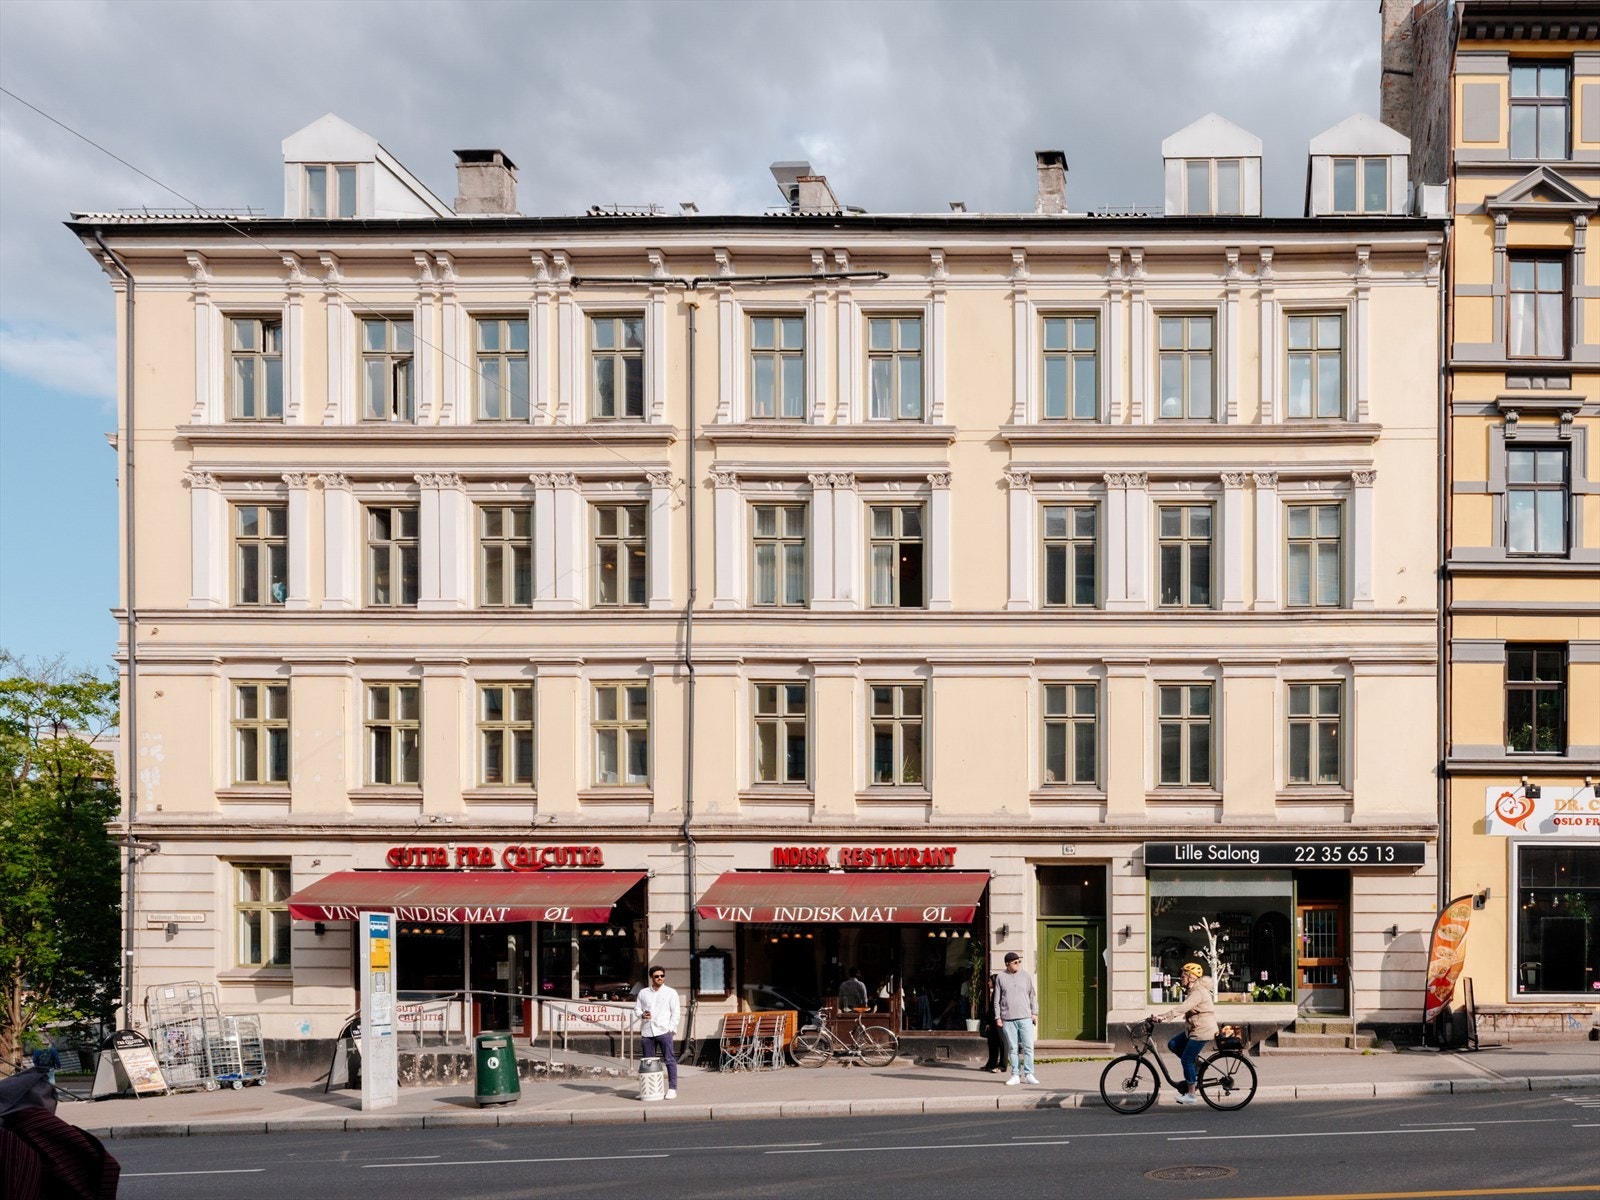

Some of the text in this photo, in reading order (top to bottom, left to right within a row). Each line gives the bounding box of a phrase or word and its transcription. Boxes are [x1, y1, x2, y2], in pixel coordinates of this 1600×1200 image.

[1554, 799, 1584, 811] DR.
[1553, 818, 1583, 826] OSLO
[386, 845, 605, 872] GUTTA FRA CALCUTTA
[773, 846, 957, 867] INDISK RESTAURANT
[1175, 844, 1395, 864] Lille Salong 22 35 65 13
[320, 905, 573, 922] VIN INDISK MAT ØL
[715, 906, 952, 922] VIN INDISK MAT ØL
[577, 1005, 607, 1013] GUTTA
